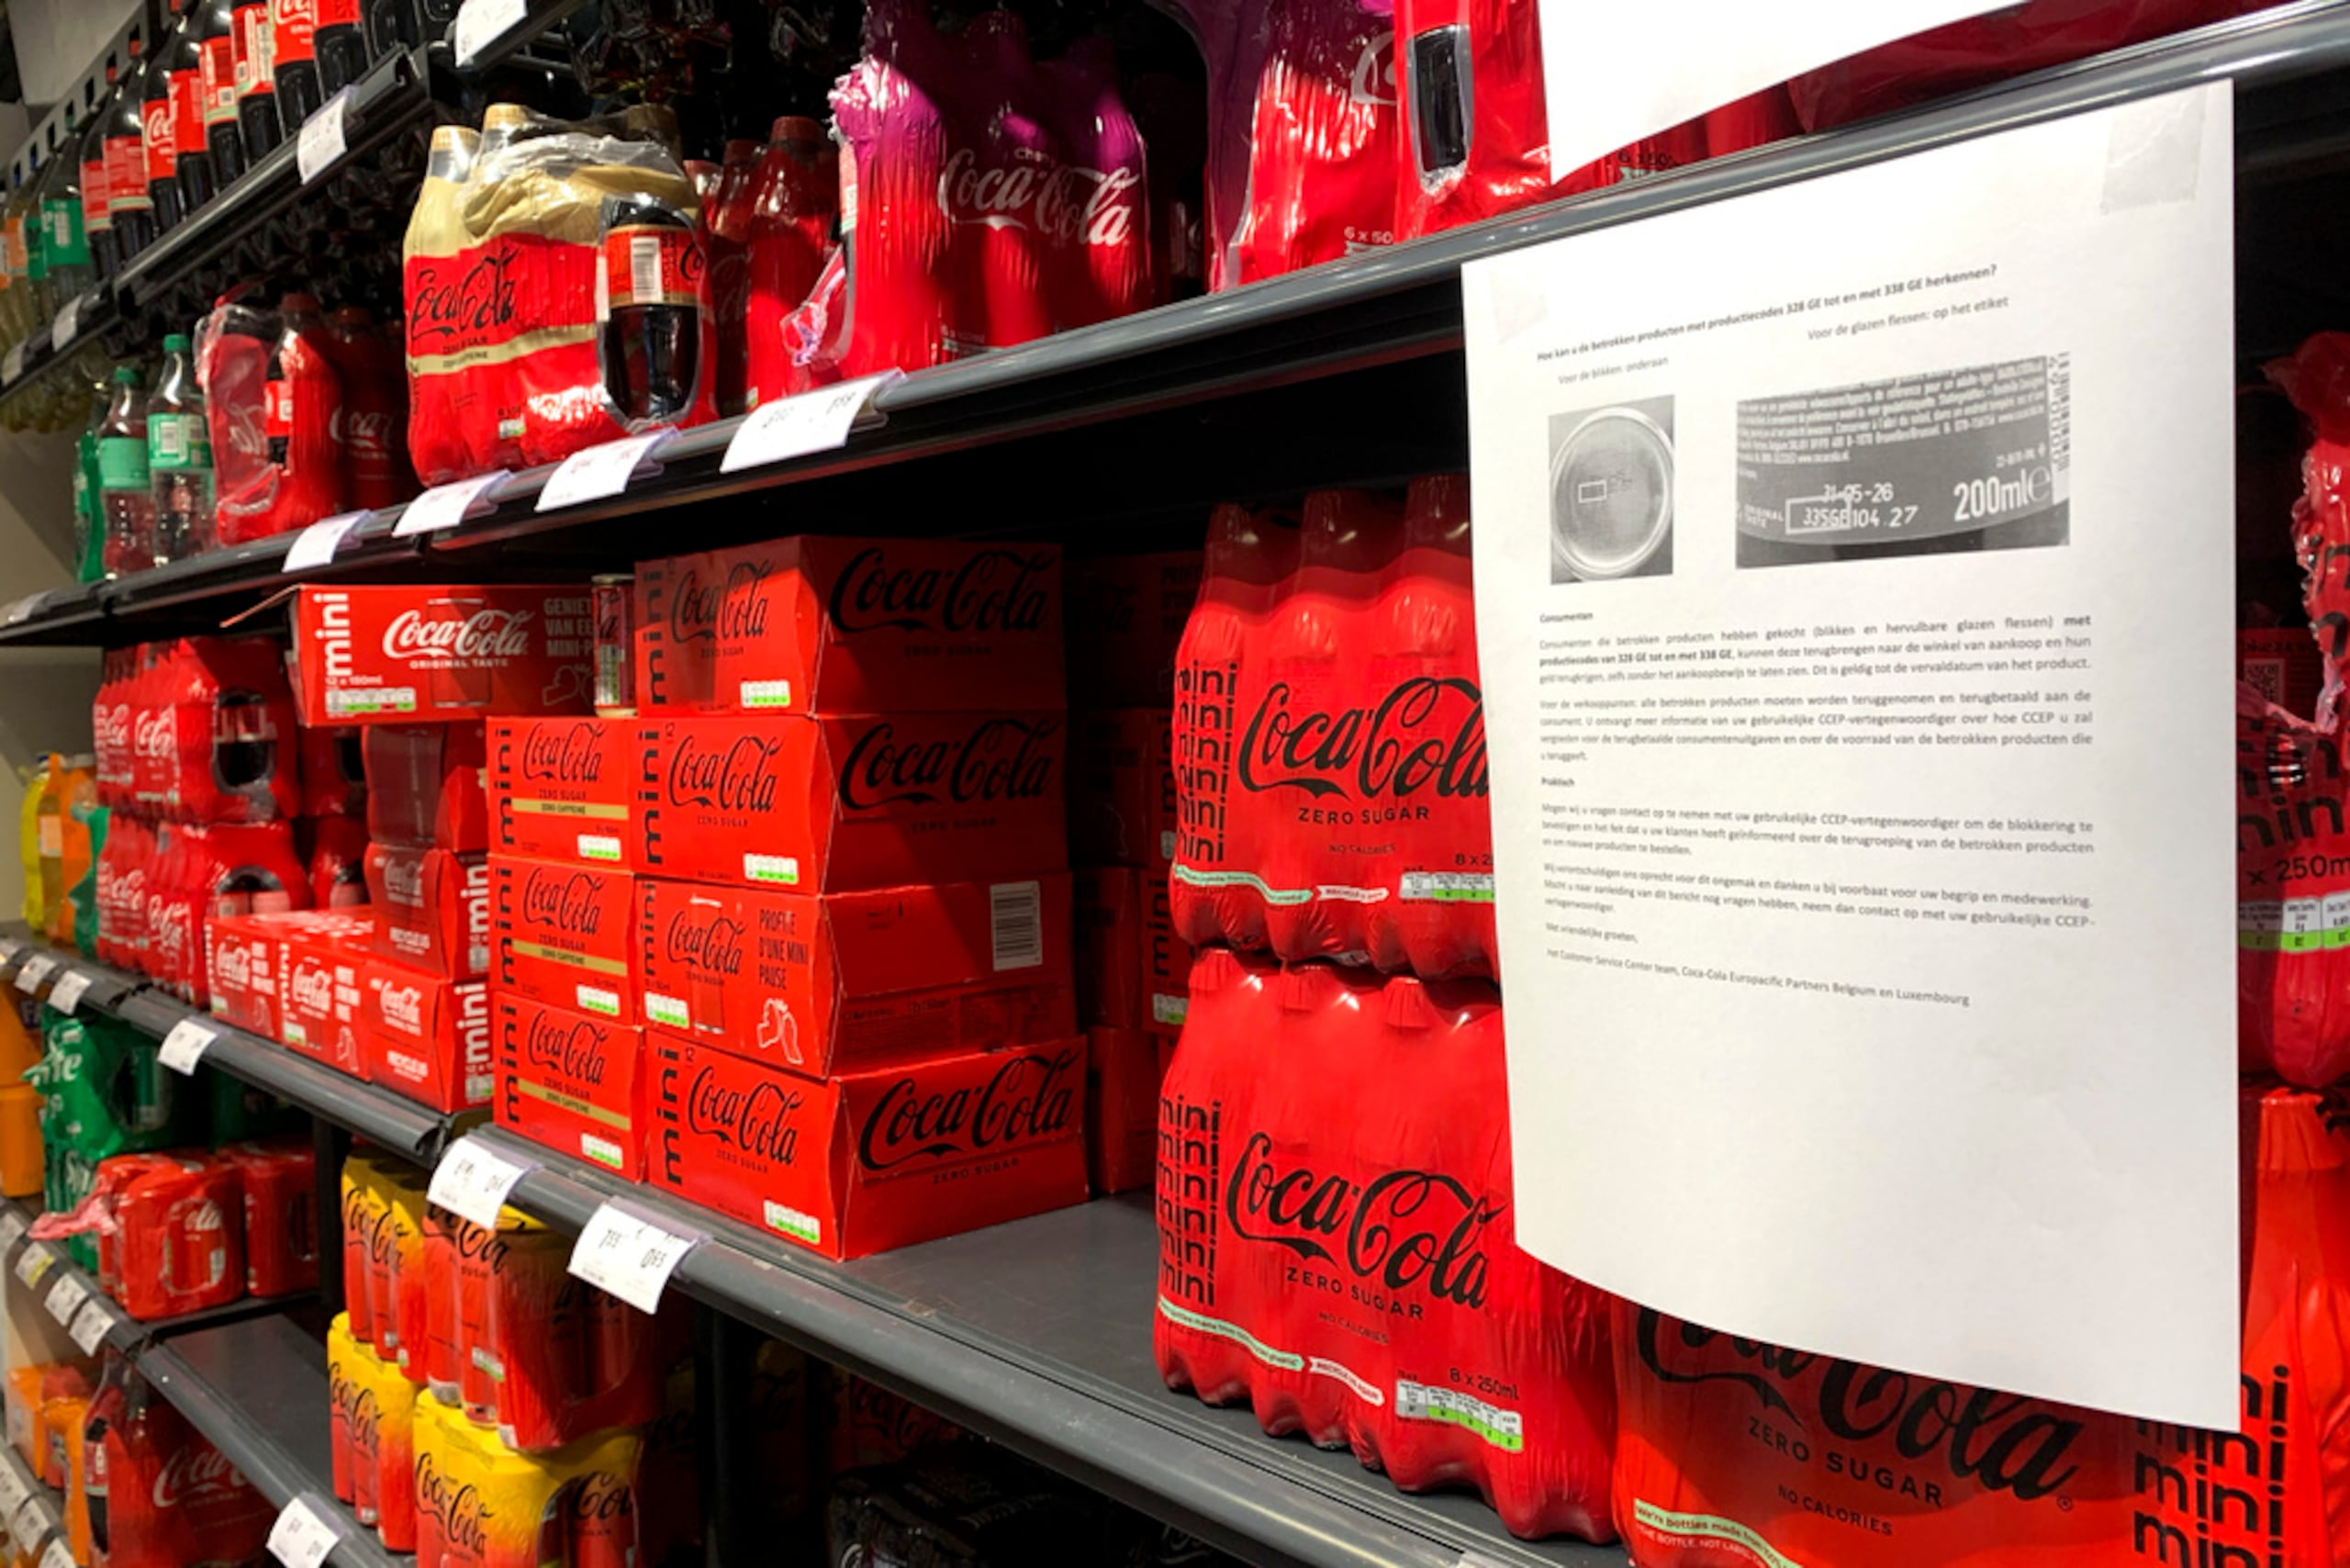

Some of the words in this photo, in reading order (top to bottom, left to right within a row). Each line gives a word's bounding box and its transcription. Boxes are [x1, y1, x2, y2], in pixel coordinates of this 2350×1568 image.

[937, 149, 1140, 246] Coca-Cola
[1707, 305, 1784, 330] productiecodes
[1785, 300, 1805, 314] 328
[1806, 297, 1821, 310] GE
[1823, 293, 1841, 308] tot
[1841, 292, 1857, 304] en
[1858, 286, 1881, 300] met
[1884, 281, 1905, 296] 338
[1906, 277, 1922, 291] GE
[1925, 264, 1998, 287] herkennen?
[1807, 325, 1833, 340] Voor
[1834, 322, 1849, 335] de
[1850, 317, 1886, 334] glazen
[1886, 309, 1930, 326] flessen:
[1931, 307, 1949, 321] op
[1950, 302, 1971, 316] het
[1973, 296, 2009, 312] etiket
[1887, 505, 1919, 528] 27
[671, 559, 775, 644] Coca-Cola
[829, 547, 1059, 633] Coca-Cola
[314, 592, 353, 678] mini
[383, 609, 534, 659] Coca-Cola
[644, 571, 666, 704] mini
[1802, 644, 1875, 657] terugbrengen
[1921, 641, 1961, 652] winkel
[1987, 638, 2042, 652] aankoop
[1812, 625, 1855, 639] (blikken
[1885, 622, 1948, 634] hervulbare
[1956, 619, 1995, 633] glazen
[2004, 617, 2053, 631] flessen)
[2063, 615, 2091, 627] met
[1840, 664, 1874, 677] geldig
[1909, 661, 1985, 673] vervaldatum
[2034, 658, 2090, 671] product.
[1807, 695, 1848, 705] worden
[1851, 693, 1935, 707] teruggenomen
[1958, 692, 2039, 705] terugbetaald
[1817, 713, 1957, 727] CCEP-vertegenwoordiger
[2020, 712, 2055, 723] CCEP
[523, 722, 606, 781] Coca-Cola
[839, 719, 1061, 811] Coca-Cola
[1841, 734, 1892, 745] voorraad
[1935, 734, 1998, 745] betrokken
[2000, 734, 2068, 746] producten
[638, 730, 663, 865] mini
[668, 734, 785, 812] Coca-Cola
[1298, 807, 1353, 824] ZERO
[1361, 806, 1430, 824] SUGAR
[1819, 813, 1960, 829] CCEP-vertegenwoordiger
[2006, 819, 2076, 833] blokkering
[1455, 853, 1466, 865] 8
[1840, 834, 1914, 849] terugroeping
[1958, 838, 2022, 850] betrokken
[2025, 840, 2095, 855] producten
[2276, 855, 2350, 882] 250m
[523, 867, 606, 935] Coca-Cola
[1773, 879, 1811, 892] danken
[1837, 883, 1888, 897] voorbaat
[1940, 890, 1979, 903] begrip
[2000, 892, 2090, 909] medewerking.
[1801, 902, 1832, 913] neem
[1857, 904, 1901, 917] contact
[1969, 911, 2052, 928] gebruikelijke
[2053, 915, 2095, 928] CCEP-
[667, 911, 748, 975] Coca-Cola
[1785, 978, 1830, 992] Partners
[1831, 982, 1876, 999] Belgium
[1895, 988, 1970, 1006] Luxembourg
[454, 982, 489, 1064] mini
[528, 1009, 608, 1086] Coca-Cola
[657, 1046, 683, 1186] mini
[688, 1065, 804, 1166] Coca-Cola
[860, 1047, 1082, 1170] Coca-Cola
[933, 1165, 970, 1186] ZERO
[1226, 1132, 1506, 1310] Coca-Cola
[1286, 1267, 1343, 1294] ZERO
[1351, 1285, 1425, 1321] SUGAR
[1449, 1367, 1460, 1383] 8
[1638, 1307, 2084, 1501] CcaCola
[1748, 1415, 1811, 1462] ZERO
[1825, 1451, 1943, 1508] SUGAR
[2137, 1419, 2288, 1482] ni
[1777, 1484, 1799, 1503] NO
[1802, 1495, 1895, 1537] CALORIES
[2134, 1450, 2285, 1537] mini
[2134, 1510, 2285, 1568] mini
